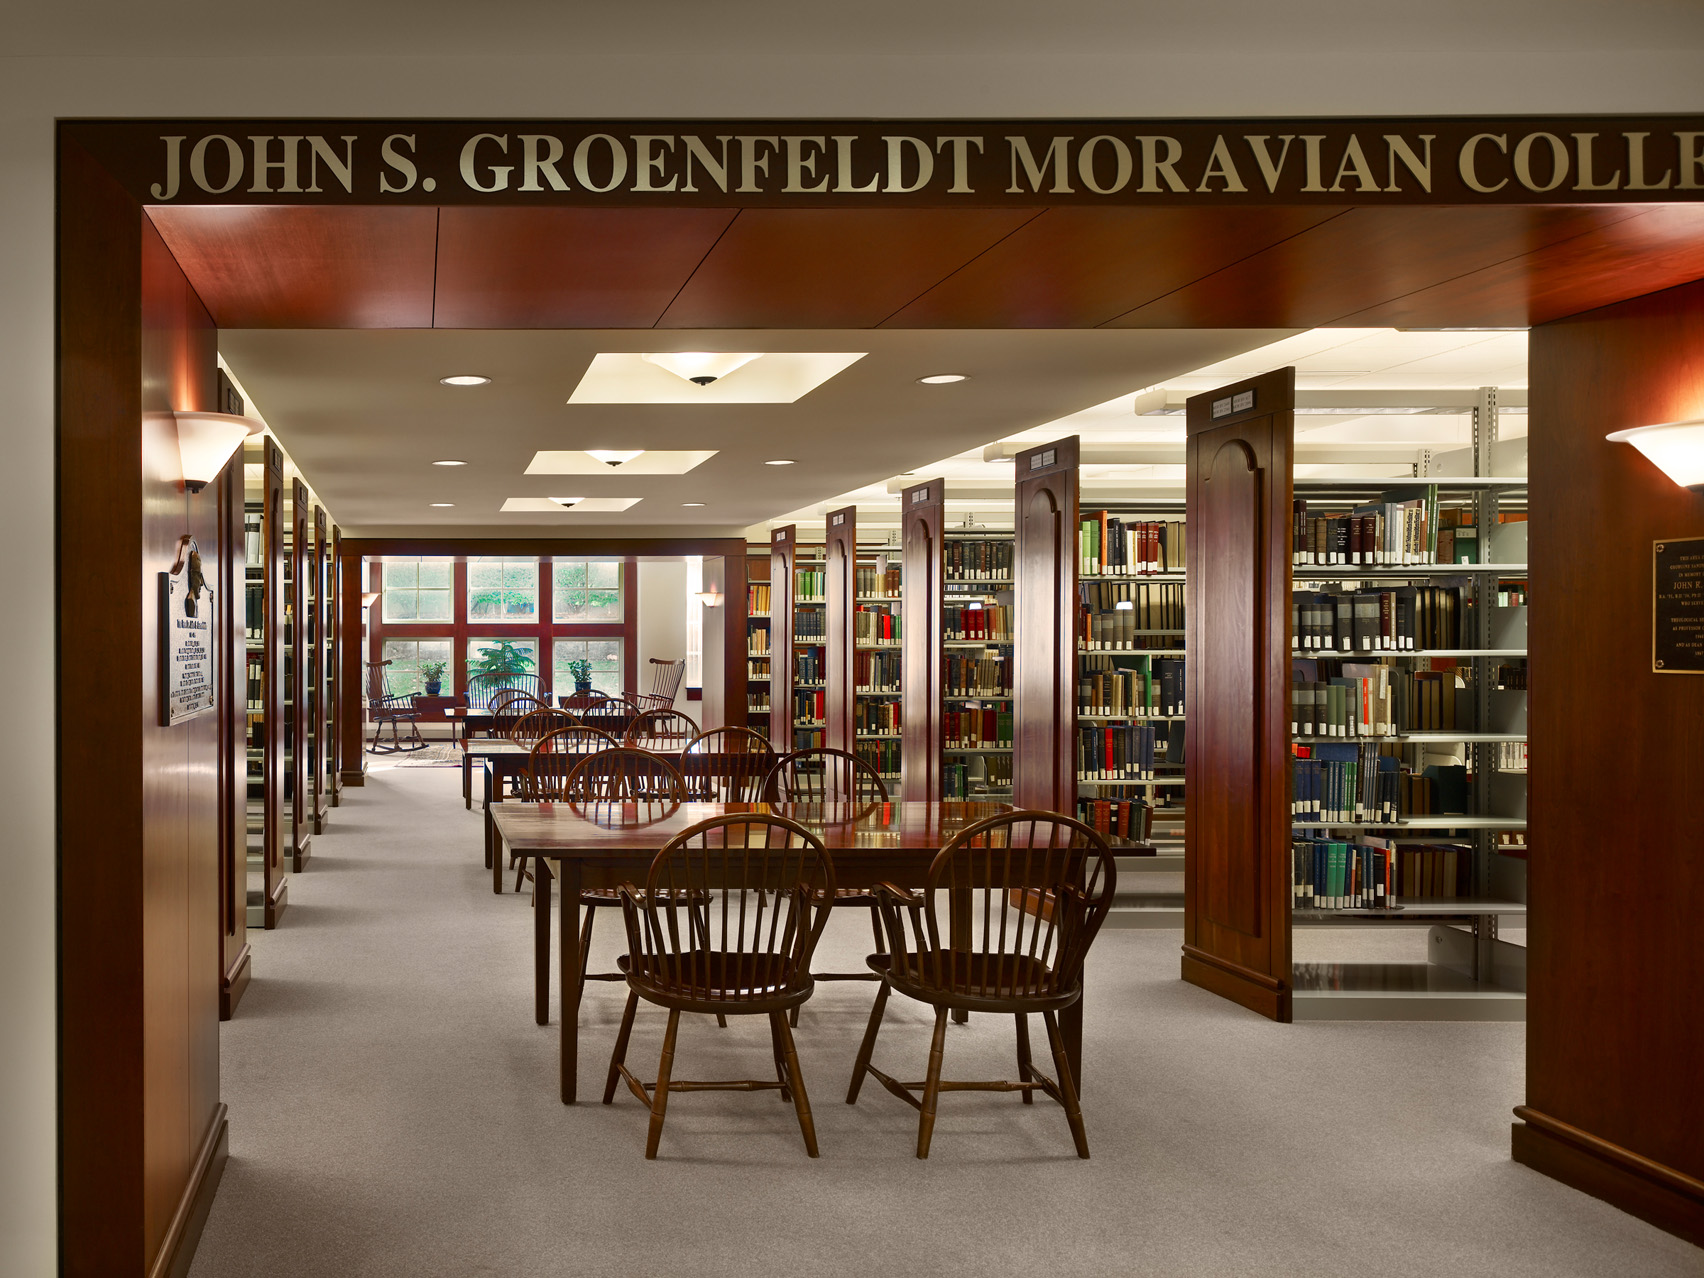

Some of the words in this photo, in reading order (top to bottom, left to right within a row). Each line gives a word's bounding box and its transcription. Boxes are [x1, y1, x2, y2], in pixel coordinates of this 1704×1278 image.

[150, 134, 358, 200] JOHN
[379, 133, 437, 194] S.
[459, 133, 984, 195] GROENFELDT
[1004, 133, 1437, 195] MORAVIAN
[1673, 581, 1693, 590] JOHN
